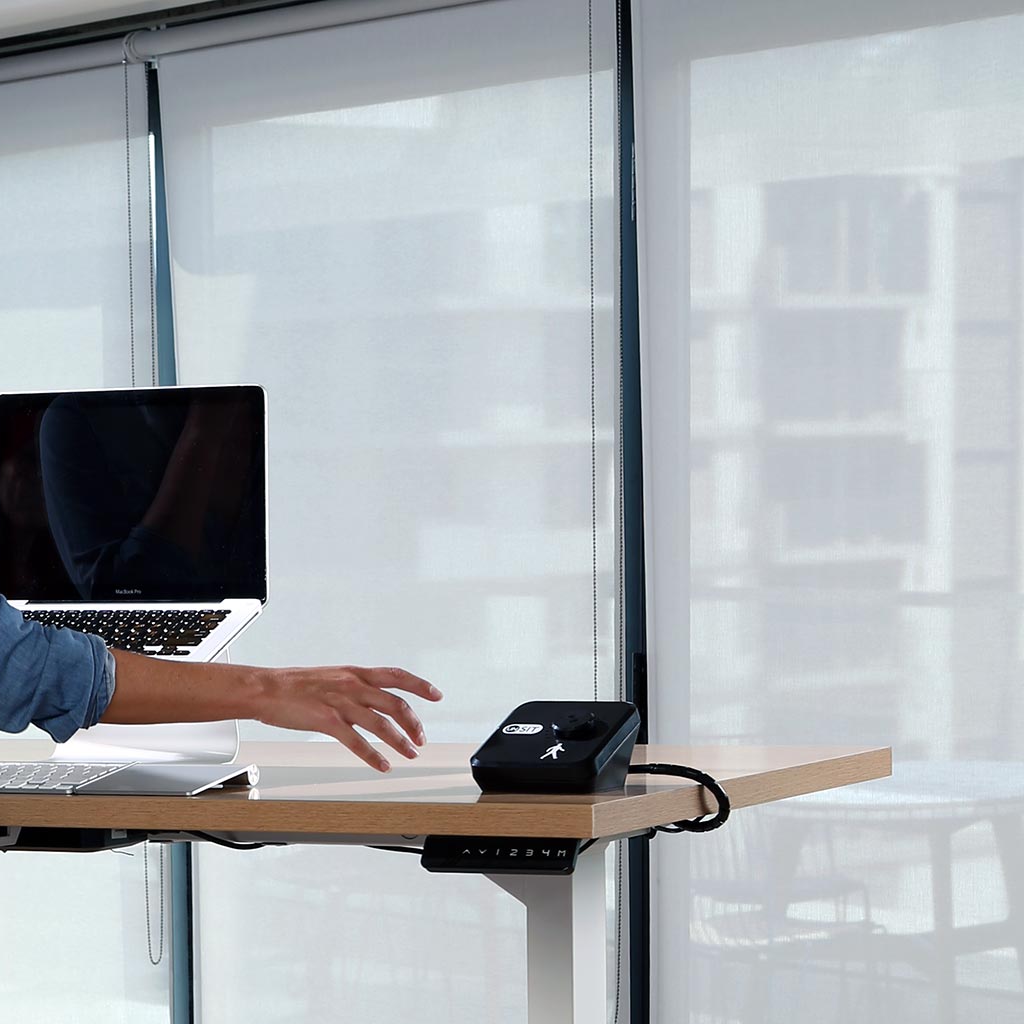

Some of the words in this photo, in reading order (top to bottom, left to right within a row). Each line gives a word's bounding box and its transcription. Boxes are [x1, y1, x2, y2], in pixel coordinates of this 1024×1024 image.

[509, 848, 519, 857] 2
[525, 849, 534, 857] 3
[541, 849, 551, 857] 4
[557, 849, 567, 857] M
